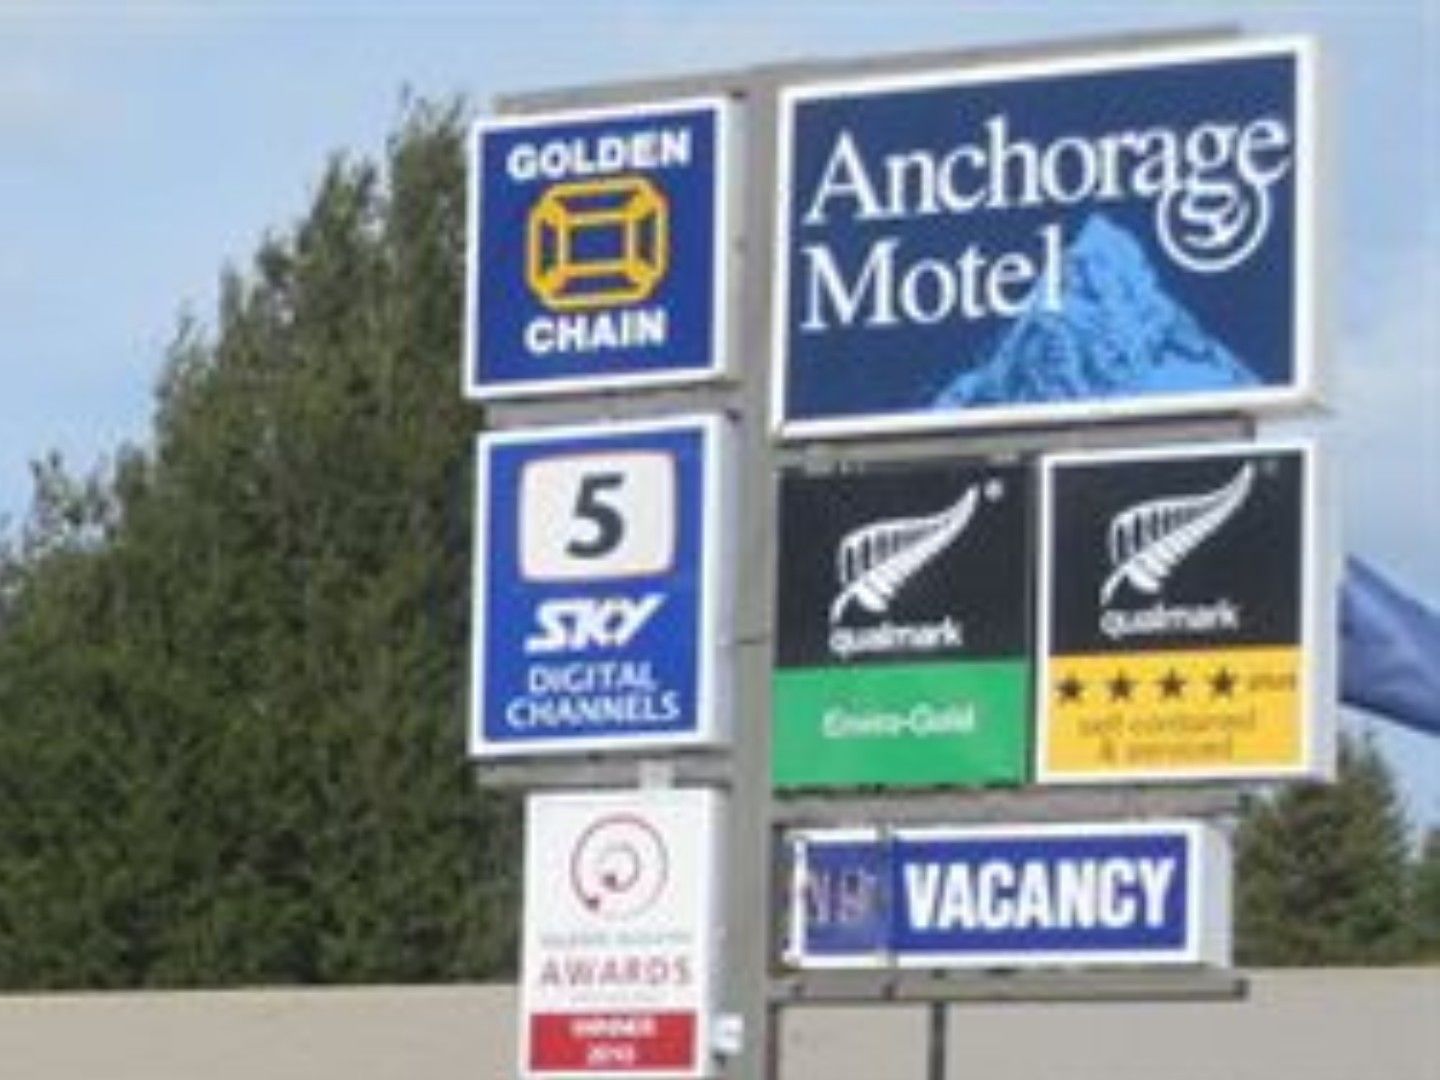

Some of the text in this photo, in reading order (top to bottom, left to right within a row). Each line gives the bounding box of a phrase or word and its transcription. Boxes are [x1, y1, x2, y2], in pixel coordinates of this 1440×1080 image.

[506, 128, 690, 179] GOLDEN
[801, 112, 1292, 272] Anchorage
[799, 224, 1062, 334] Motel
[525, 309, 666, 354] CHAIN
[564, 472, 626, 559] 5
[523, 592, 667, 655] SKY
[528, 661, 656, 694] DIGITAL
[505, 692, 681, 728] CHANNELS
[903, 857, 1176, 929] VACANCY
[541, 955, 694, 986] AWARDS
